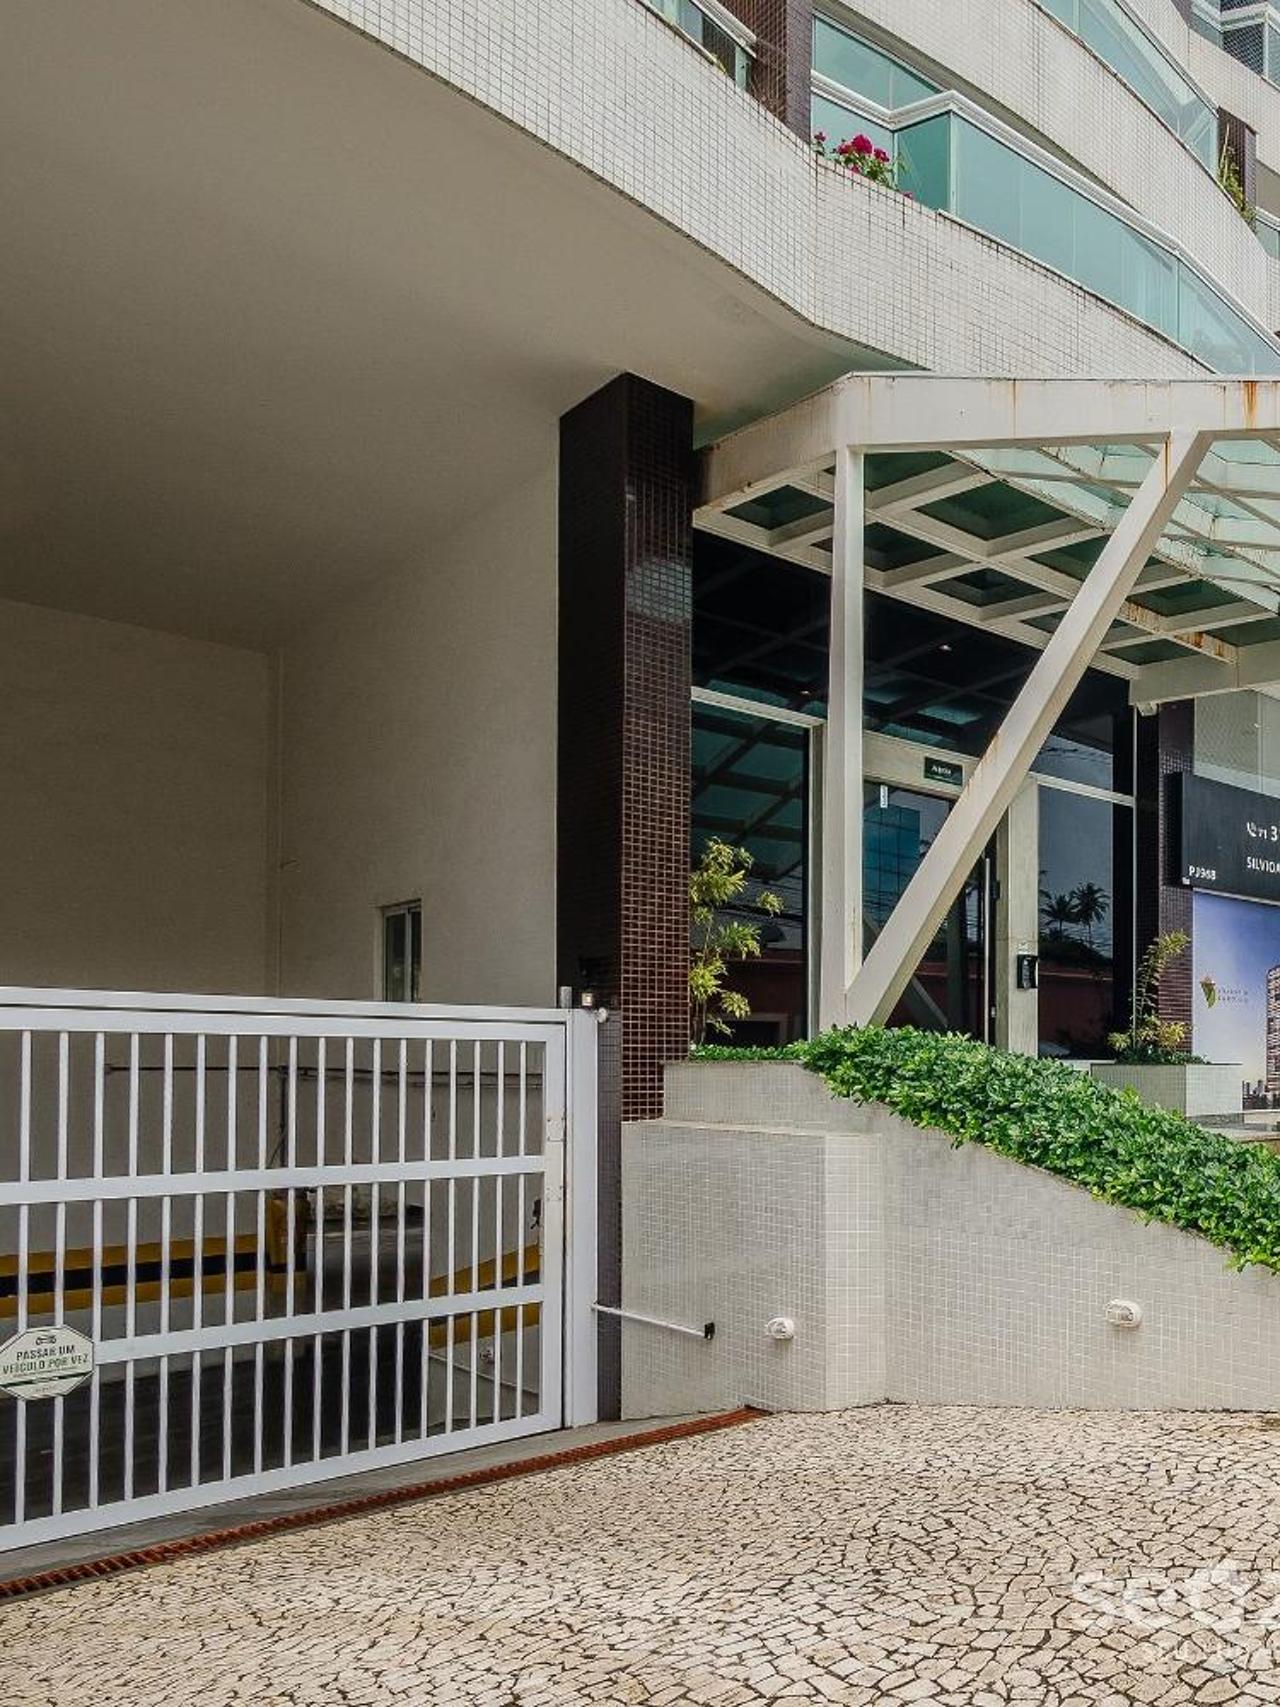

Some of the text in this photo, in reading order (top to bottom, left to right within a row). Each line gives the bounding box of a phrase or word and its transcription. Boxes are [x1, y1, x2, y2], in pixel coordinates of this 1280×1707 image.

[16, 1344, 75, 1361] PASSAR UM
[48, 1358, 69, 1368] POR
[71, 1353, 89, 1364] VEZ
